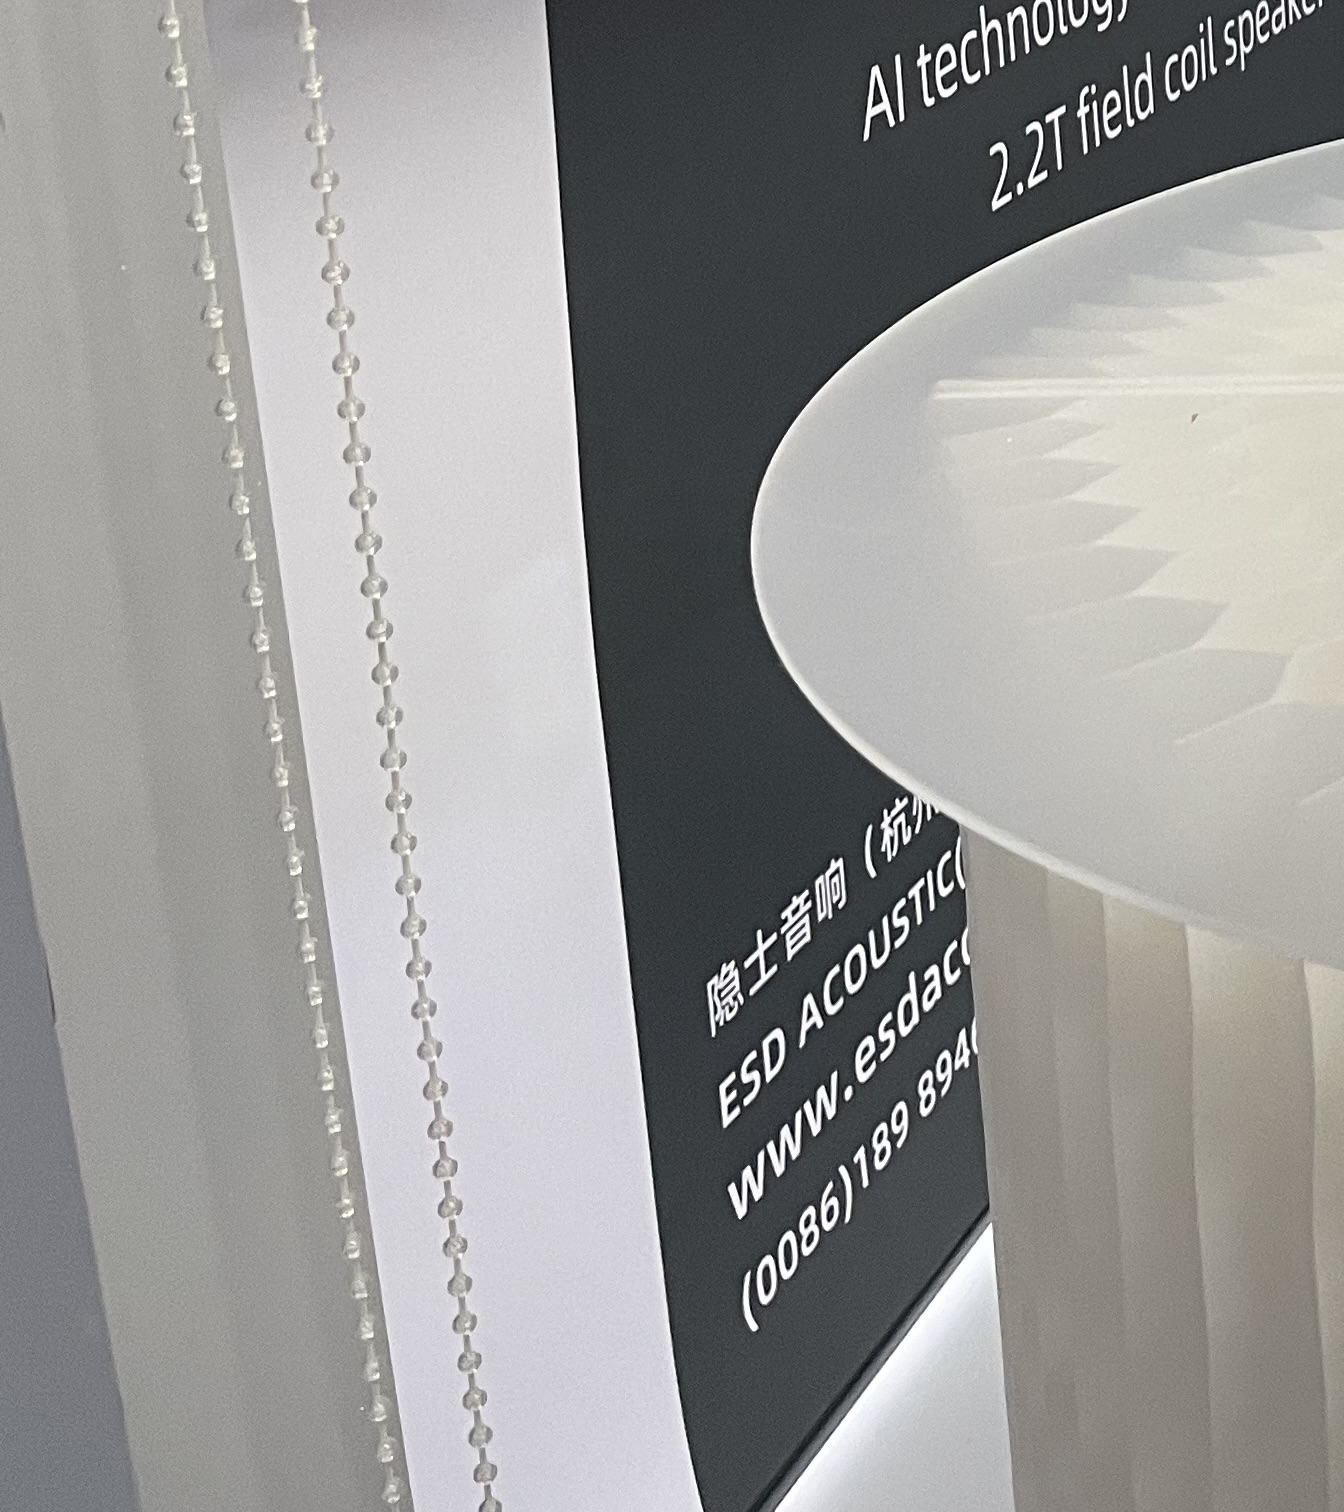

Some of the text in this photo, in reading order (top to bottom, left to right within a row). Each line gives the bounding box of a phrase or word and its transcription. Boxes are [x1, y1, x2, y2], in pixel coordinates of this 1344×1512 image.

[861, 54, 905, 142] AI
[988, 106, 1071, 212] 2.2T
[1076, 51, 1157, 156] field
[1163, 17, 1218, 102] coil
[720, 835, 966, 1129] ESD ACOUSTIC(
[742, 1100, 909, 1332] (0086)189
